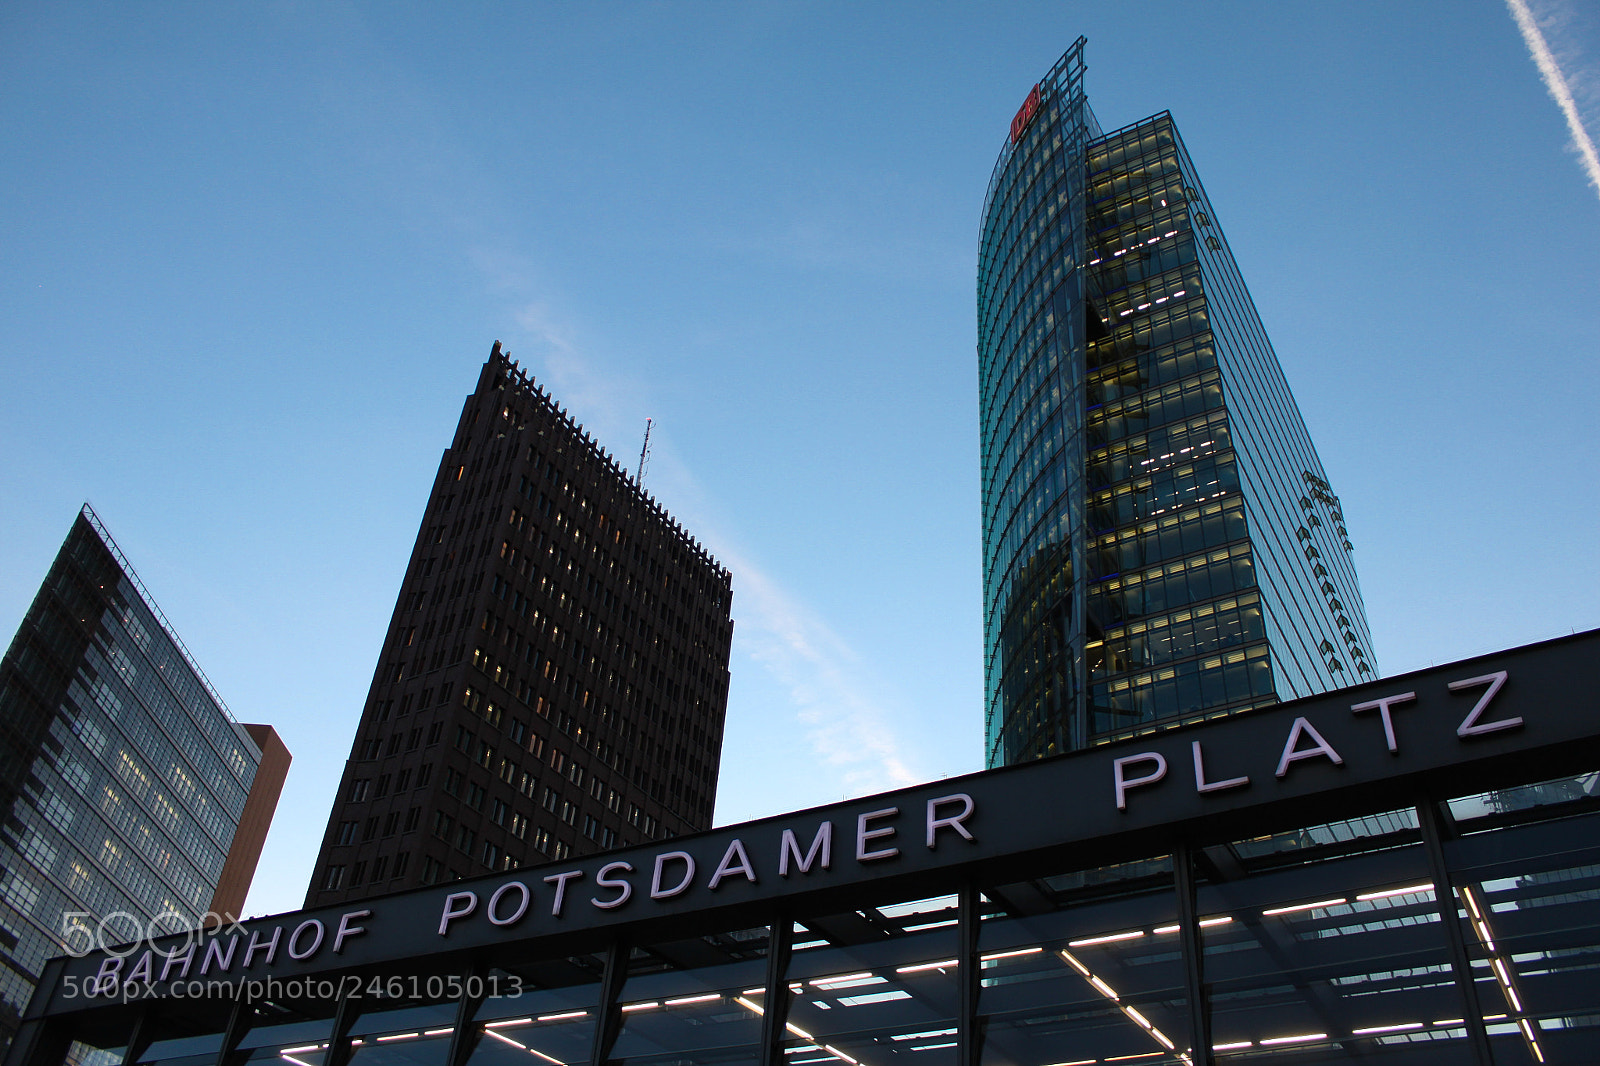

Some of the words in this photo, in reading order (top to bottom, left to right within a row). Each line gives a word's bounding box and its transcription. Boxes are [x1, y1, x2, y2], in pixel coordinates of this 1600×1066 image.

[92, 909, 372, 993] BAHNHOF
[437, 793, 975, 937] POTSDAMER
[1112, 669, 1524, 811] PLATZ
